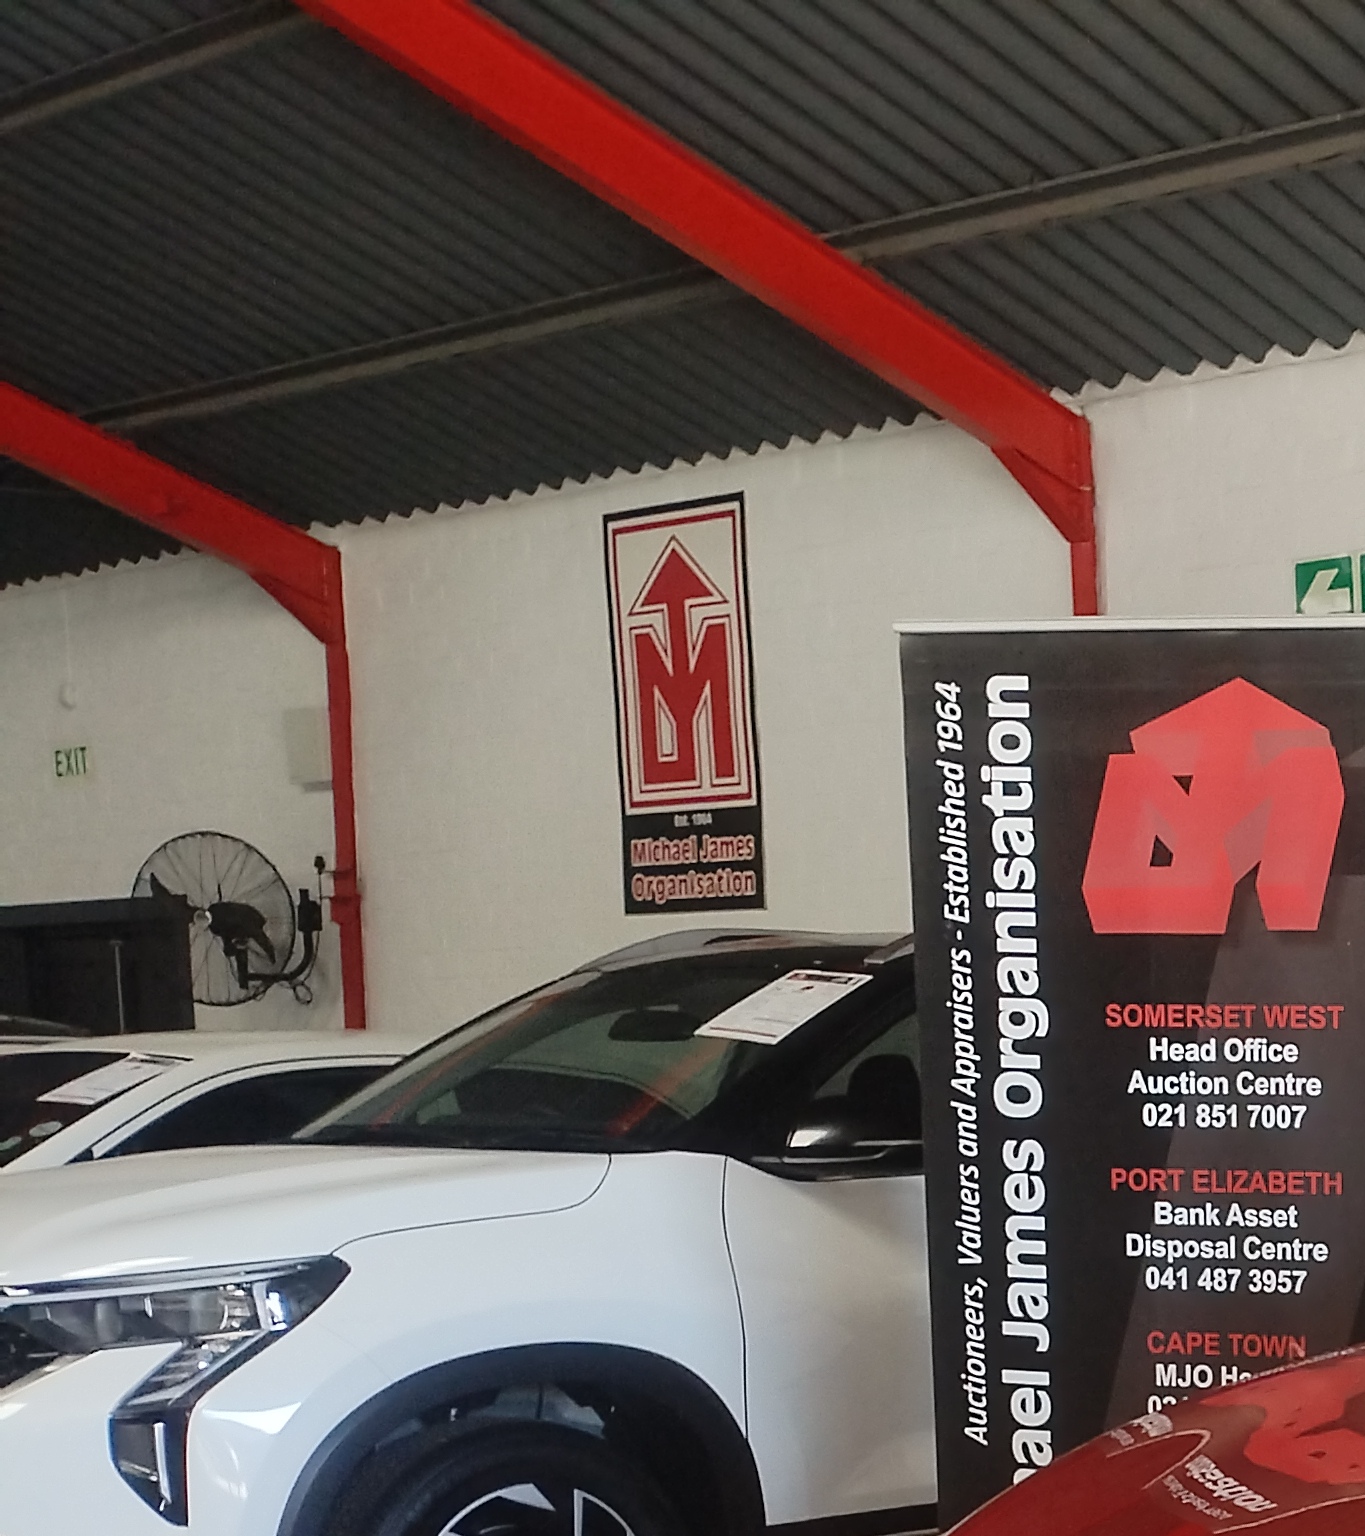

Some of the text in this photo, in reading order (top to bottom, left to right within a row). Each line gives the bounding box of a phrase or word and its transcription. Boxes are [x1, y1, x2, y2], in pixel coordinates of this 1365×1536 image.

[935, 681, 962, 753] 1964
[55, 747, 87, 777] EXIT
[631, 834, 755, 867] Michael James
[938, 760, 971, 924] Established
[631, 867, 756, 904] Organisation
[981, 673, 1050, 1119] Organisation
[946, 949, 983, 1098] Appraisers
[1104, 1004, 1344, 1030] SOMERSET WEST
[1149, 1038, 1299, 1064] Head Office
[1128, 1070, 1322, 1097] Auction Centre
[951, 1096, 979, 1157] and
[1142, 1103, 1307, 1130] 021 851 7007
[1111, 1168, 1343, 1195] PORT ELIZABETH
[955, 1163, 982, 1266] Valuers
[1154, 1201, 1298, 1229] Bank Asset
[1002, 1138, 1050, 1353] James
[1125, 1233, 1329, 1263] Disposal Centre
[1146, 1266, 1307, 1294] 041 487 3957
[1146, 1330, 1307, 1358] CAPE TOWN
[962, 1277, 989, 1446] Auctioneers,
[1155, 1363, 1213, 1388] MJO
